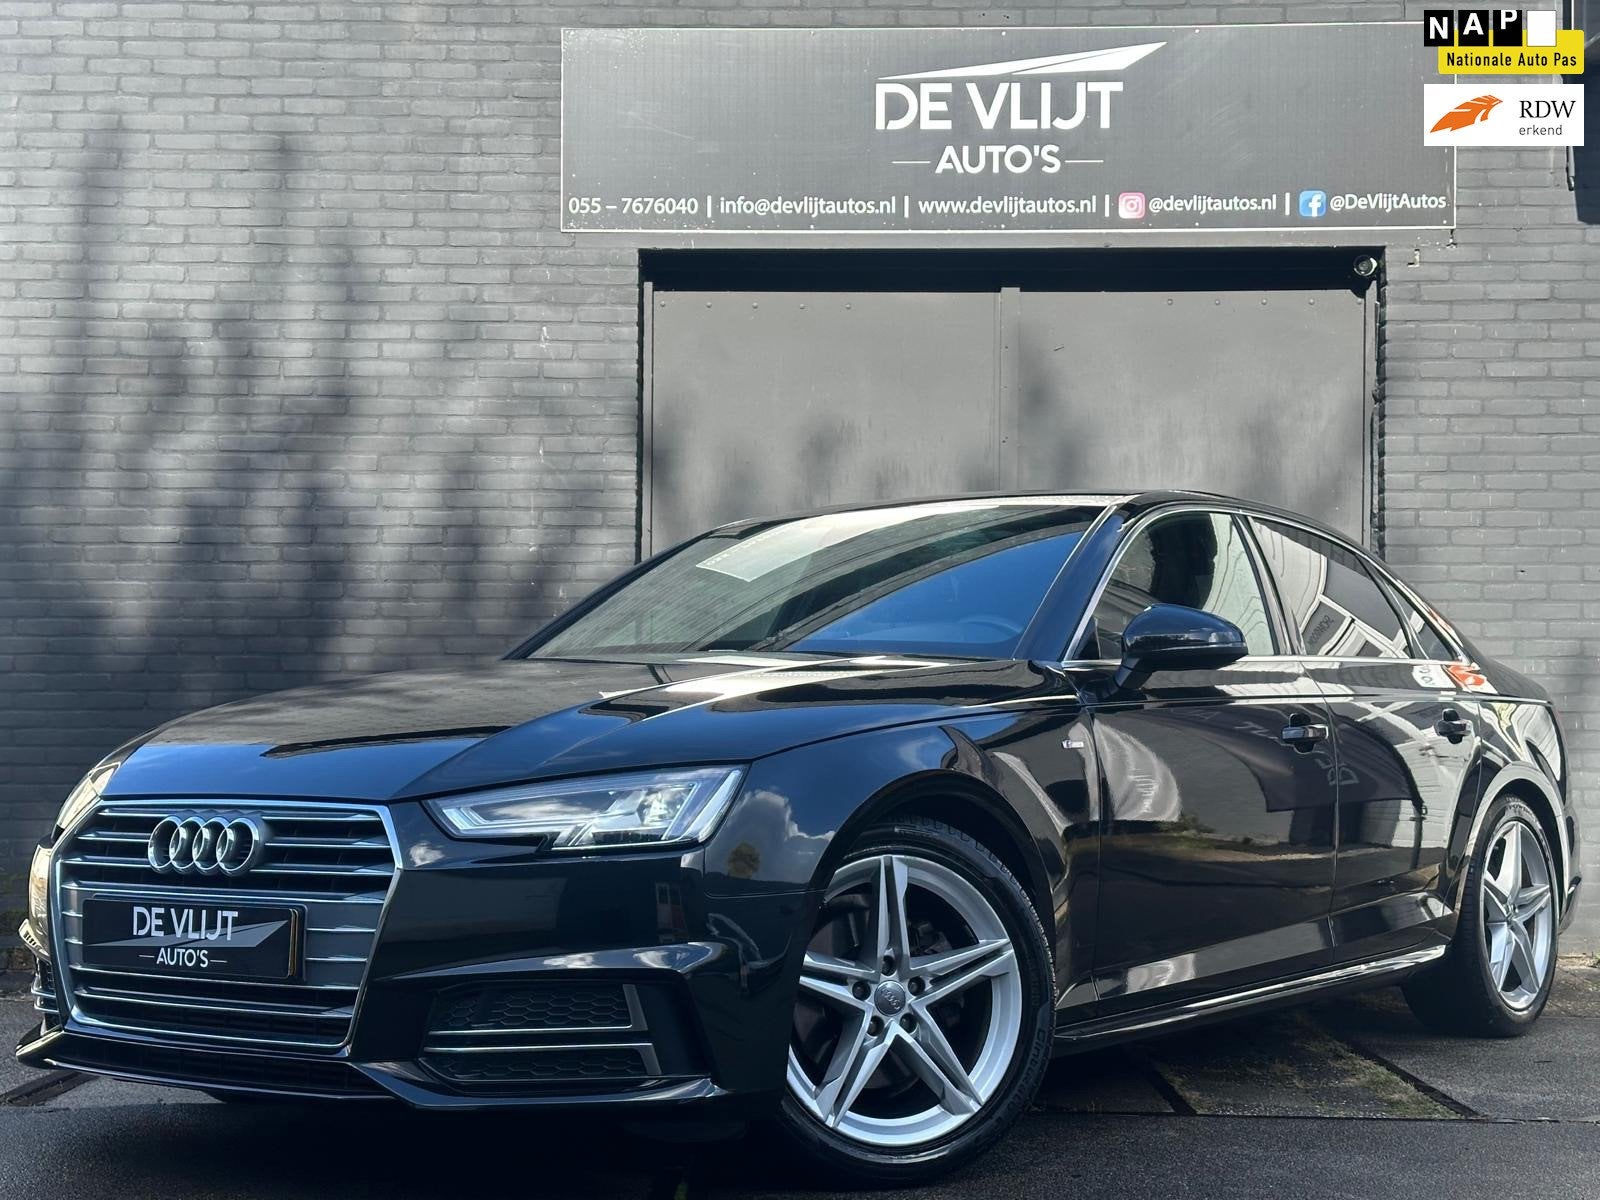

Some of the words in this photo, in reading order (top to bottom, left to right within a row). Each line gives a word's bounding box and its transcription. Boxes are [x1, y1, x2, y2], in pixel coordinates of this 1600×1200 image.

[875, 82, 953, 130] DE
[965, 81, 1124, 130] VLIJT
[935, 144, 1061, 174] AUTO'S
[568, 197, 602, 214] 055
[621, 197, 699, 214] 7676040
[720, 195, 897, 216] info@devlijtautos.nl
[918, 195, 1097, 216] www.devlijtautos.nl
[1148, 194, 1277, 215] @devlijtautos.nl
[1329, 193, 1447, 213] @DeVlijtAutos
[132, 906, 165, 937] DE
[170, 908, 239, 941] VLIJT
[156, 947, 209, 968] AUTO'S
